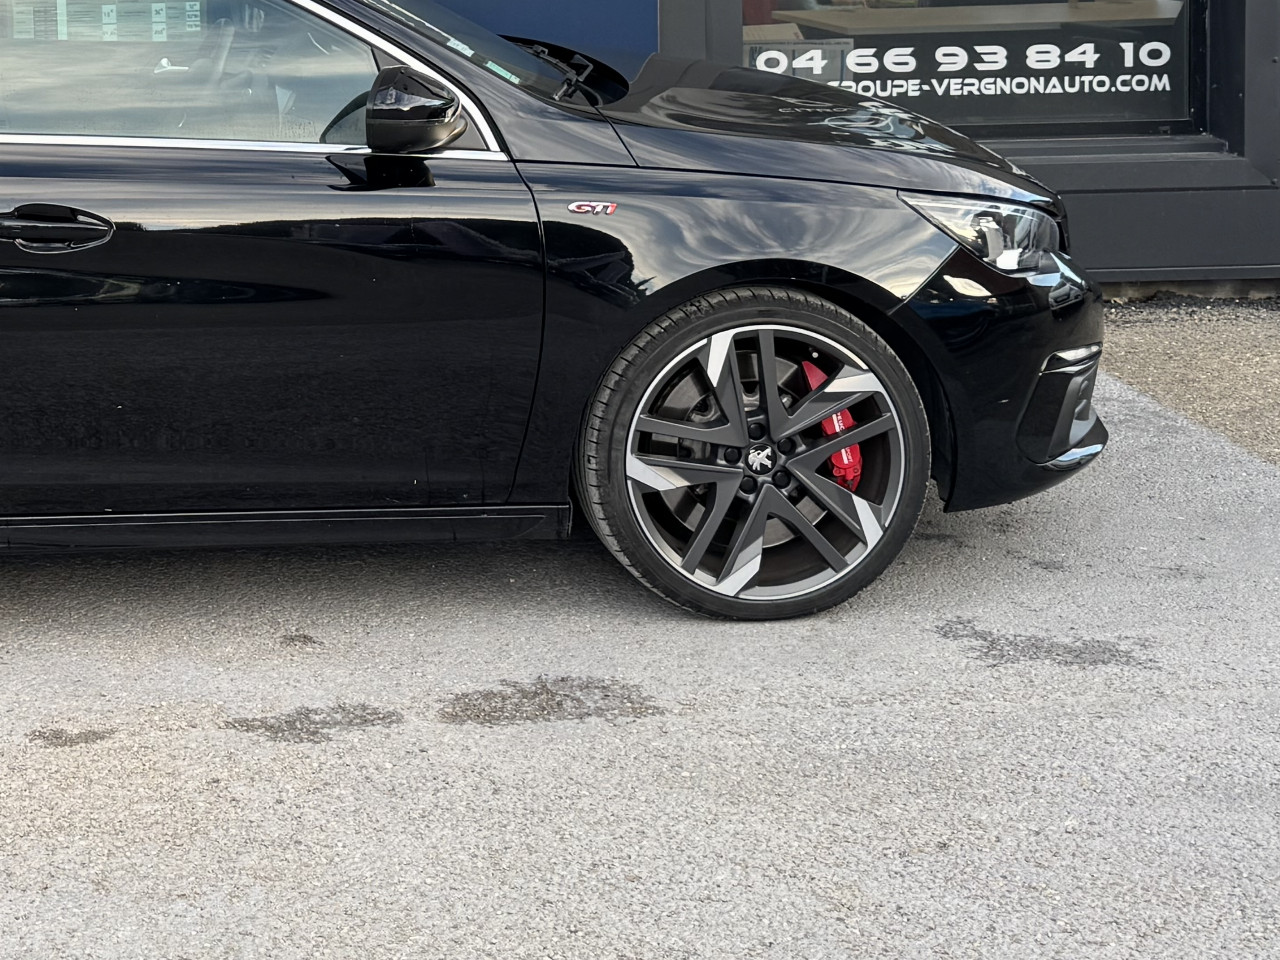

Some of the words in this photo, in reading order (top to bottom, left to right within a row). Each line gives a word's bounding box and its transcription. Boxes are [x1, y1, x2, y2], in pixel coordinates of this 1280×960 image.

[756, 48, 828, 75] 04
[845, 47, 917, 73] 66
[935, 45, 1008, 72] 93
[1025, 43, 1101, 69] 84
[1120, 41, 1172, 67] 10
